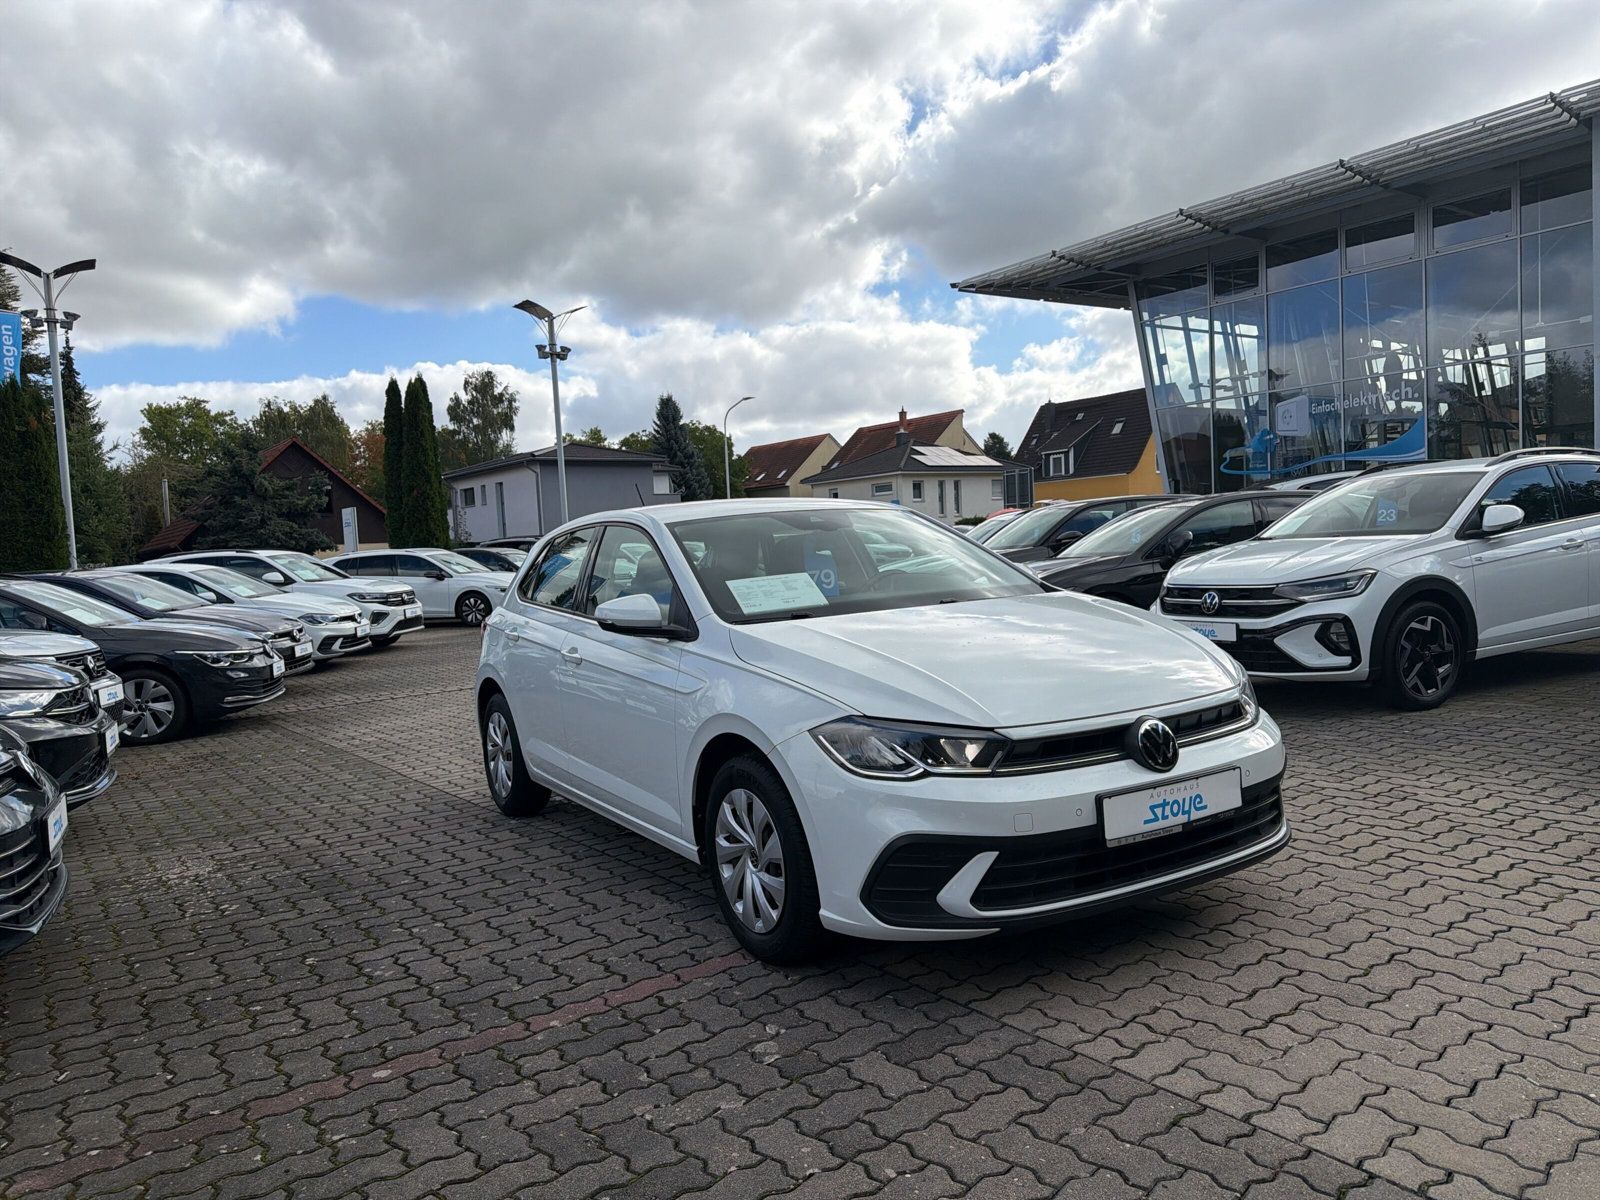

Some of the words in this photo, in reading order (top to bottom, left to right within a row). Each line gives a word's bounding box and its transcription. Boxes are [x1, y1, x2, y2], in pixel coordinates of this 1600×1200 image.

[1311, 398, 1340, 414] Einfach
[1378, 509, 1397, 522] 23
[807, 569, 835, 589] 79
[1149, 782, 1201, 799] AUTOHAUS
